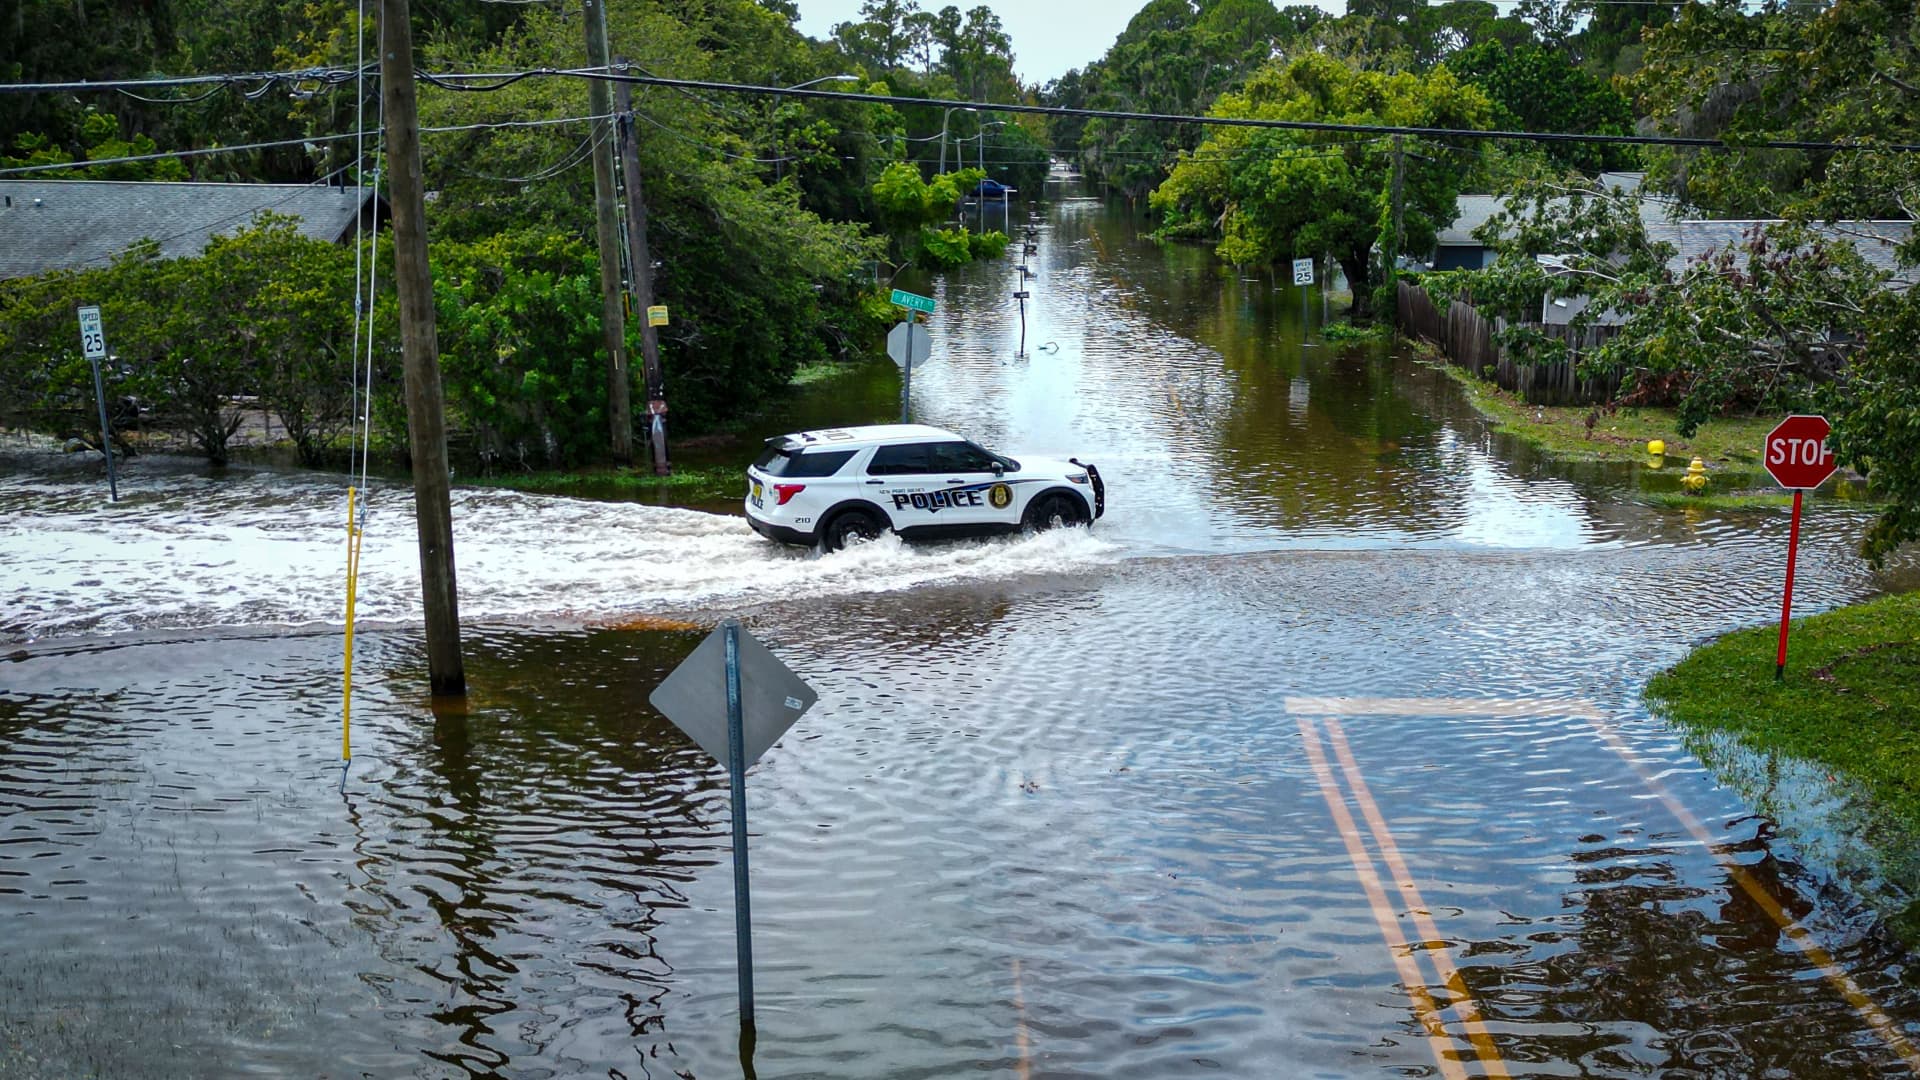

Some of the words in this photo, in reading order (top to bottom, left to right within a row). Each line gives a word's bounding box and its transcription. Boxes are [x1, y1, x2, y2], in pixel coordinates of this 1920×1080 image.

[1296, 272, 1311, 282] 25
[901, 294, 924, 309] AVERY
[81, 313, 98, 321] SPEED
[84, 323, 97, 332] LIMIT
[85, 334, 102, 352] 25
[891, 490, 984, 514] POLICE
